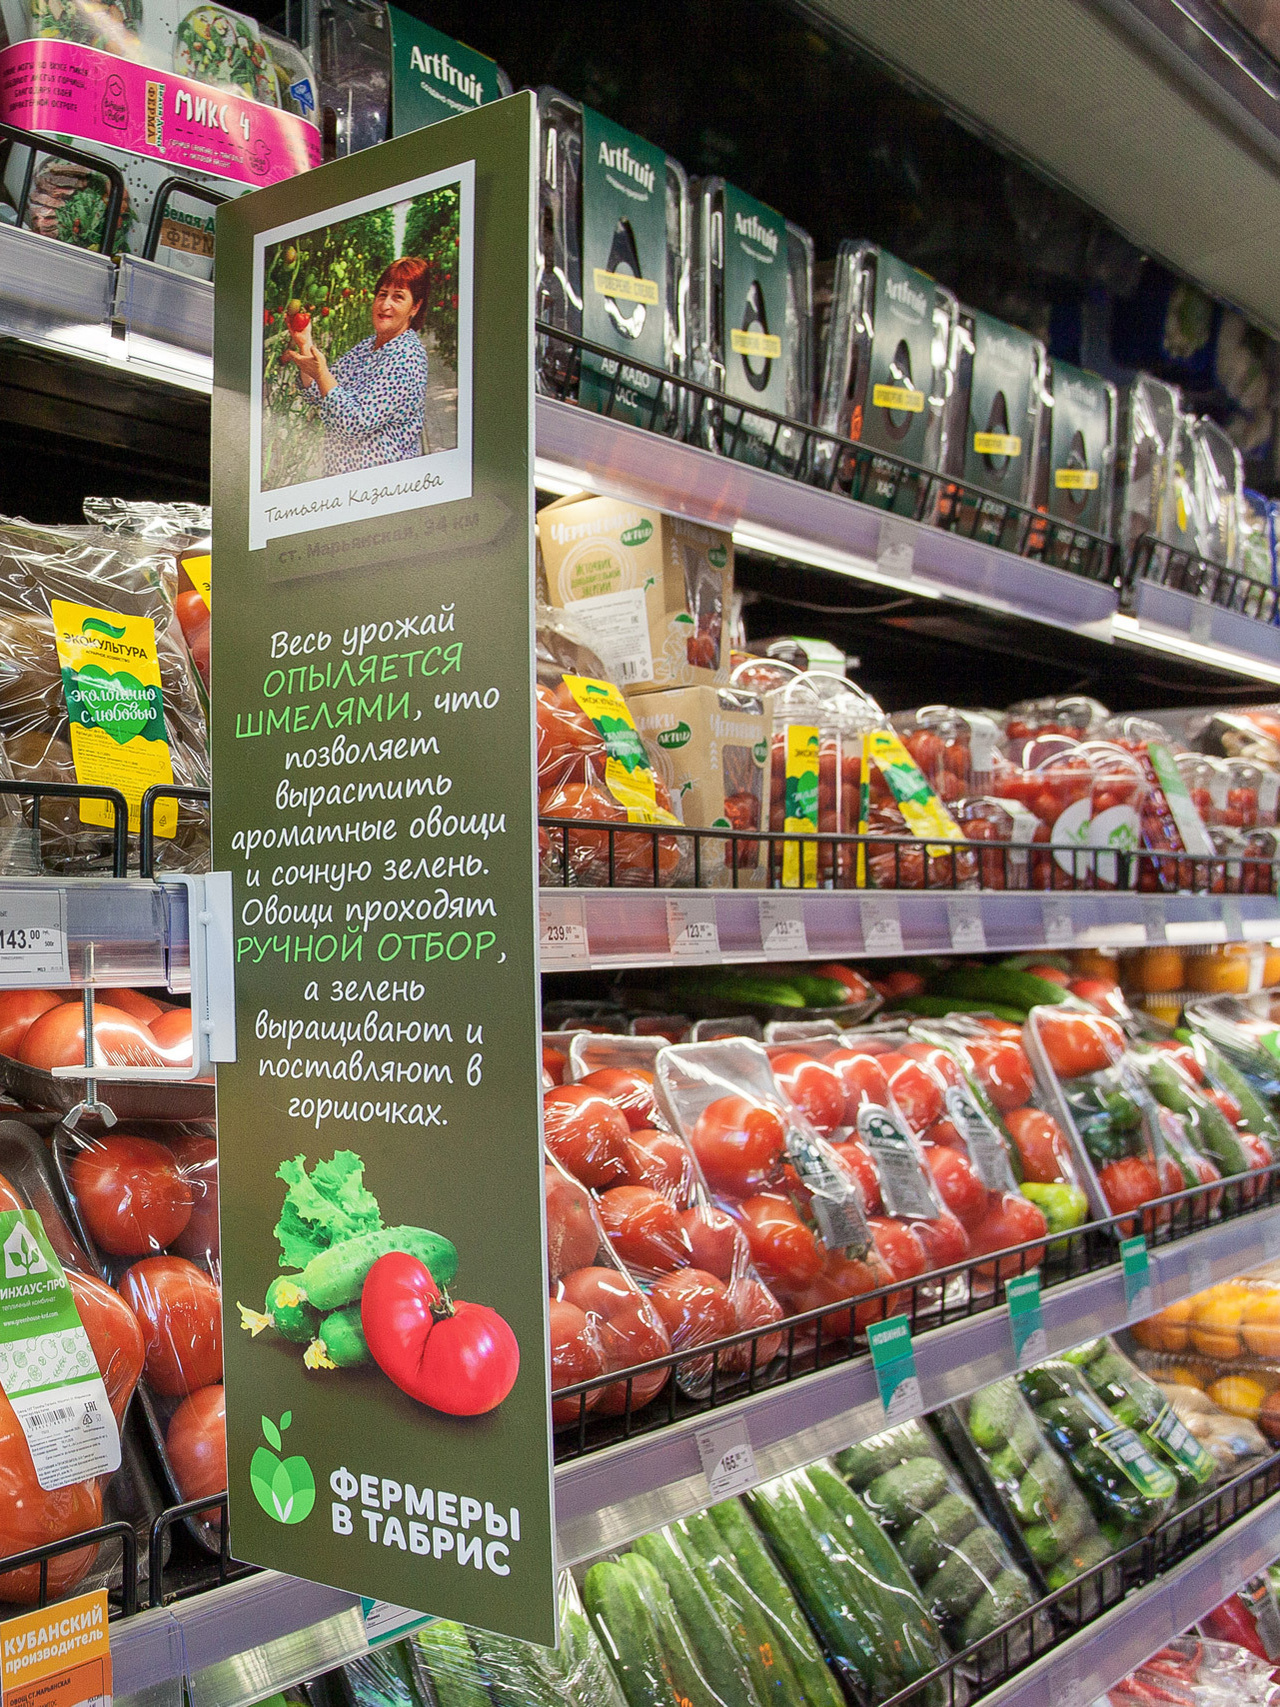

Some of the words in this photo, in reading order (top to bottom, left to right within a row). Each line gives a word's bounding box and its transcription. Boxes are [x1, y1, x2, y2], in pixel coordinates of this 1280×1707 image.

[410, 45, 484, 106] Artfruit
[146, 86, 157, 144] ФЕРМА
[175, 89, 230, 134] МИКС
[239, 112, 251, 141] 4
[598, 141, 656, 194] Artfruit
[166, 228, 214, 258] ФЕРМ
[734, 212, 779, 256] Artfruit
[601, 357, 650, 389] АВКАДО
[264, 496, 343, 524] Татьяна
[348, 472, 445, 507] Казалиева
[63, 632, 148, 660] ЭКОКУЛЬТУРА
[270, 630, 332, 659] Весь
[341, 602, 456, 656] урожай
[262, 642, 464, 698] ОПЫЛЯЕТСЯ
[235, 691, 422, 738] ШМЕЛЯМИ,
[433, 687, 500, 714] что
[285, 734, 441, 770] позволяет
[275, 774, 453, 818] вырастить
[231, 817, 397, 860] ароматные
[409, 804, 507, 841] овощи
[246, 868, 261, 887] и
[271, 860, 372, 892] сочную
[382, 854, 490, 881] зелень.
[241, 894, 333, 930] Овощи
[345, 888, 497, 932] проходят
[237, 925, 364, 963] РУЧНОЙ
[377, 930, 507, 963] ОТБОР,
[303, 980, 320, 1002] а
[330, 979, 426, 1002] зелень
[254, 1008, 454, 1050] выращивают
[466, 1023, 484, 1045] и
[258, 1049, 454, 1085] поставляют
[466, 1052, 483, 1087] в
[287, 1096, 449, 1130] горшочках.
[329, 1466, 521, 1542] ФЕРМЕРЫ
[331, 1501, 355, 1537] В
[360, 1509, 512, 1577] ТАБРИС
[4, 1603, 104, 1657] КУБАНСКИЙ
[5, 1628, 104, 1675] производитель
[9, 1694, 28, 1706] ОВОЩ
